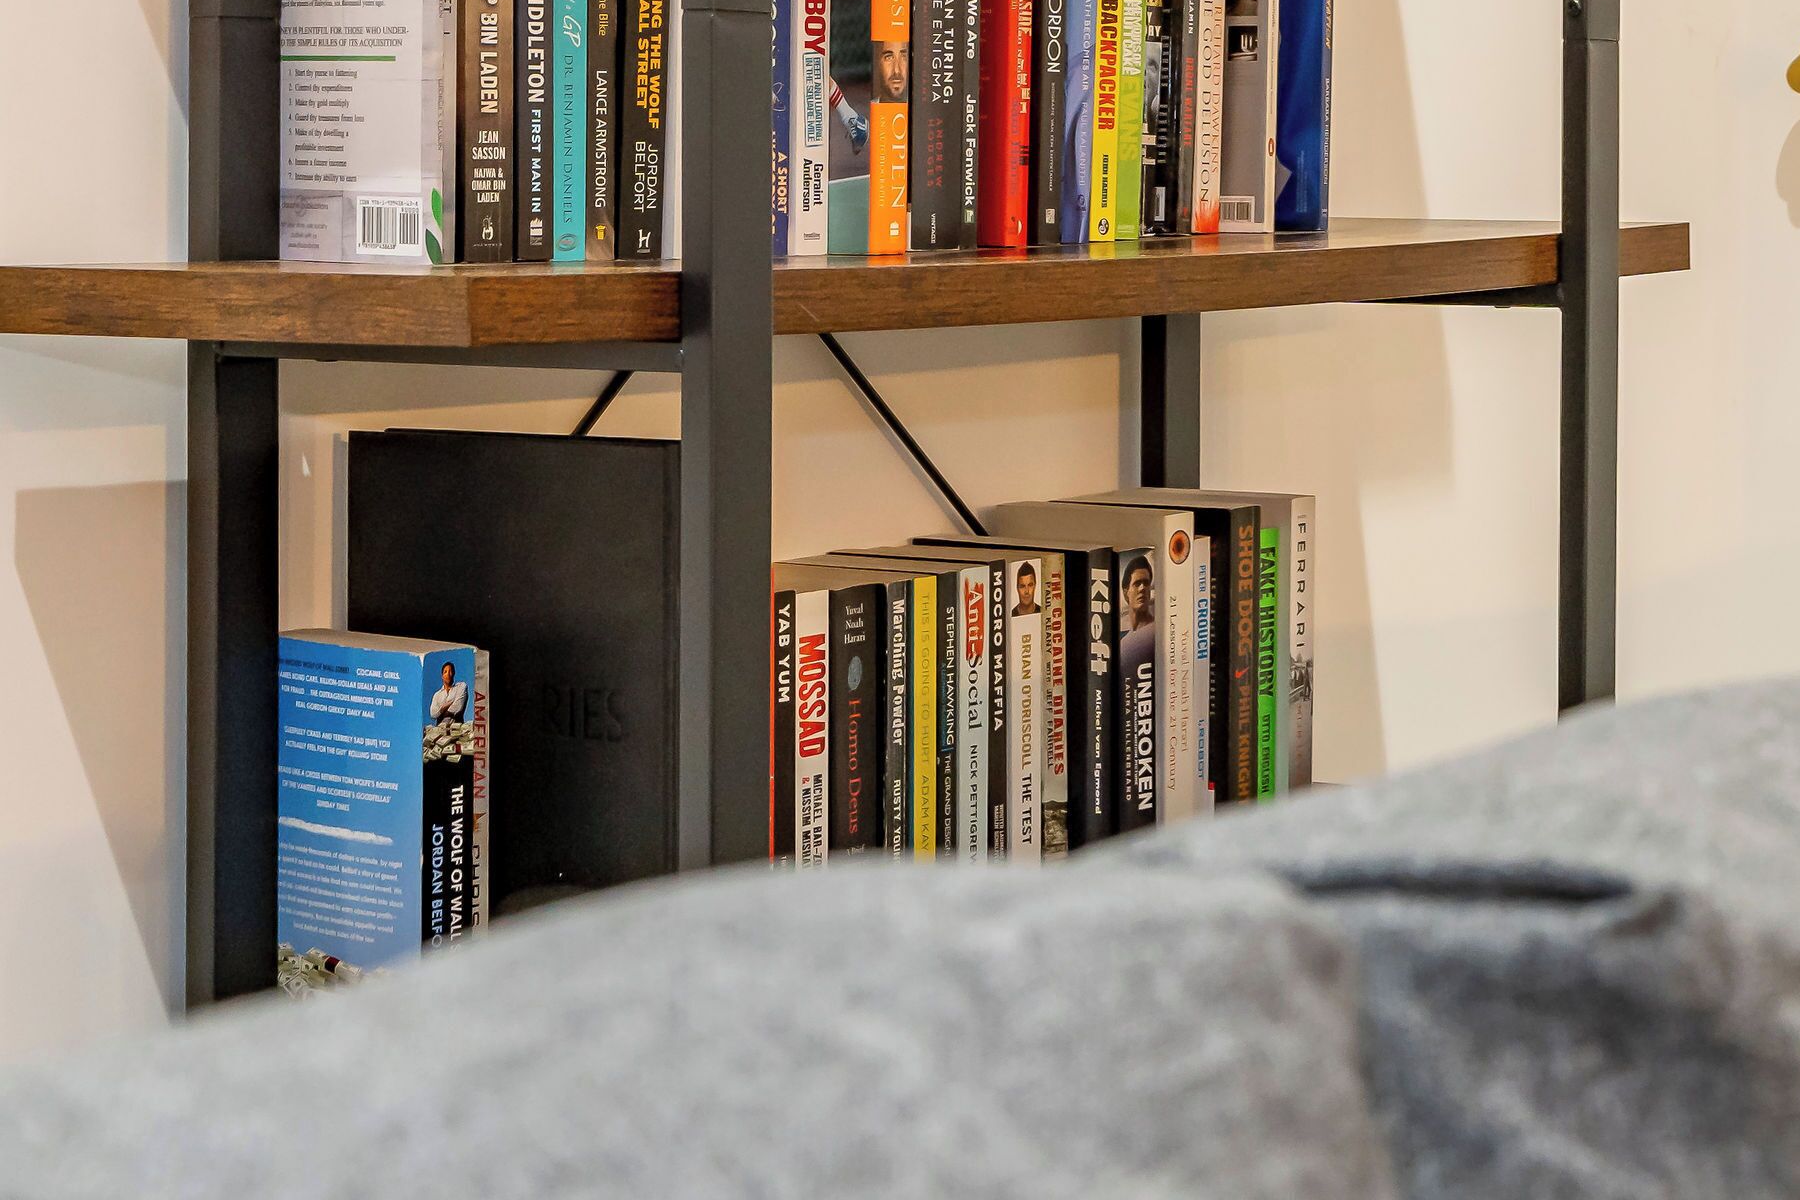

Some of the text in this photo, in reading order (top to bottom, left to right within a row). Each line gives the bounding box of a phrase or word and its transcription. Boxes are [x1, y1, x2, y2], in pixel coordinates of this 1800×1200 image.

[480, 12, 498, 46] BIN
[562, 14, 582, 48] GP
[598, 13, 609, 37] Bike
[967, 0, 978, 26] We
[636, 37, 650, 109] STREET
[650, 33, 662, 70] THE
[931, 20, 943, 103] ENIGMA
[966, 31, 978, 60] Are
[1202, 28, 1213, 79] GOD
[479, 51, 499, 114] LADEN
[595, 70, 608, 116] LANCE
[648, 74, 661, 130] WOLF
[477, 130, 499, 144] JEAN
[531, 109, 542, 152] FIRST
[965, 93, 977, 133] Jack
[1211, 92, 1221, 173] DAWKINS
[471, 146, 506, 160] SASSON
[498, 167, 504, 179] &
[594, 118, 608, 208] ARMSTRONG
[891, 113, 907, 208] OPEN
[935, 118, 944, 188] ANDREW
[964, 138, 976, 205] Fenwick
[1200, 90, 1211, 202] DELUSION
[471, 179, 491, 191] OMAR
[531, 158, 542, 192] MAN
[634, 141, 646, 213] BELFORT
[646, 143, 659, 209] JORDAN
[776, 166, 789, 213] SHORT
[802, 158, 812, 212] Anderson
[813, 163, 824, 206] Geraint
[531, 198, 541, 213] IN
[1238, 524, 1254, 592] SHOE
[1297, 522, 1307, 648] FERRARI
[845, 603, 864, 615] Yuval
[845, 618, 864, 630] Noah
[1051, 570, 1064, 687] THE COCAINE
[1197, 598, 1208, 660] CROUCH
[1259, 546, 1276, 697] FAKE HISTORY
[778, 603, 790, 703] YAB YUM
[844, 632, 866, 644] Harari
[993, 571, 1004, 732] MOCRO MAFFIA
[798, 633, 826, 759] MOSSAD
[946, 606, 955, 745] STEPHEN HAWKING
[892, 599, 906, 821] Marching Powder RUSTY
[1137, 661, 1153, 811] UNBROKEN
[969, 744, 978, 780] NICK
[1021, 633, 1033, 845] BRIAN THE TEST
[813, 773, 823, 822] MICHAEL
[848, 777, 862, 833] Deus
[920, 775, 930, 851] ADAM KAY
[1094, 762, 1102, 815] Egmond
[431, 824, 444, 894] JORDAN
[450, 784, 464, 942] THE WOLF OF WALL
